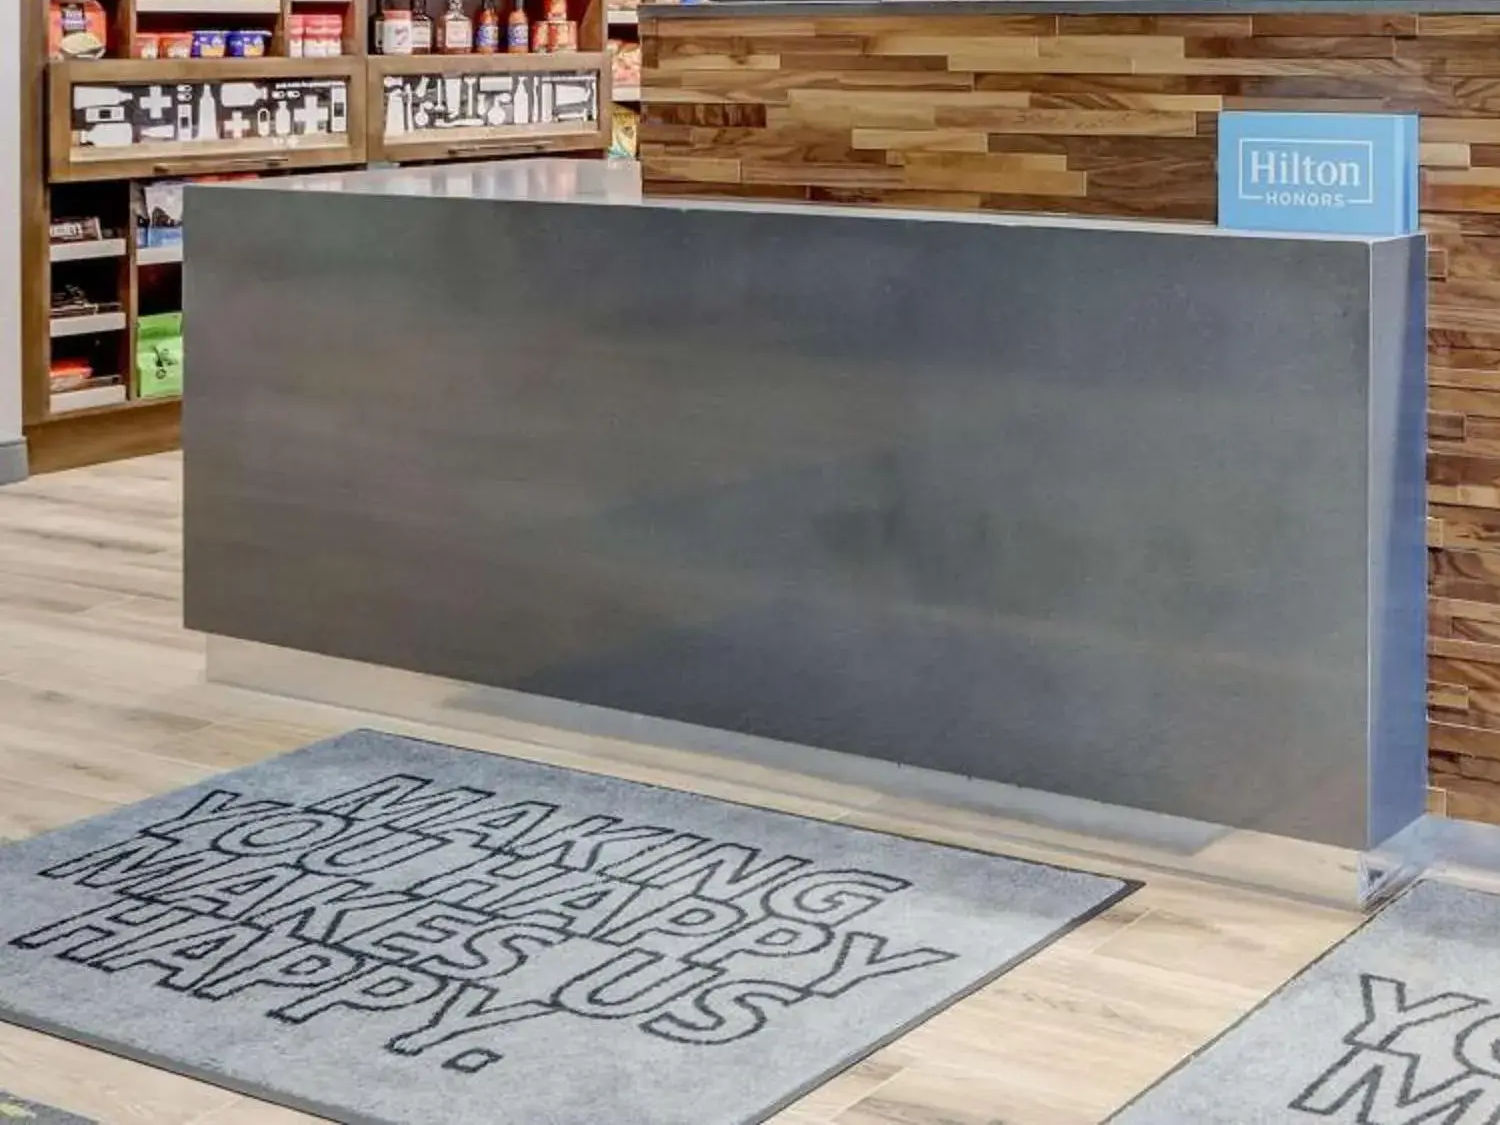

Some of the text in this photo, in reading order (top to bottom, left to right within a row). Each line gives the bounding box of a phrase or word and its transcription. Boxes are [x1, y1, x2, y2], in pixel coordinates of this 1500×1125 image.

[1251, 150, 1361, 187] Hilton
[1266, 190, 1346, 208] HONORS
[139, 789, 958, 998] YOU HAPPY
[302, 773, 912, 928] MAKING
[8, 897, 562, 1073] HAPPY.
[36, 838, 810, 1045] MAKES US
